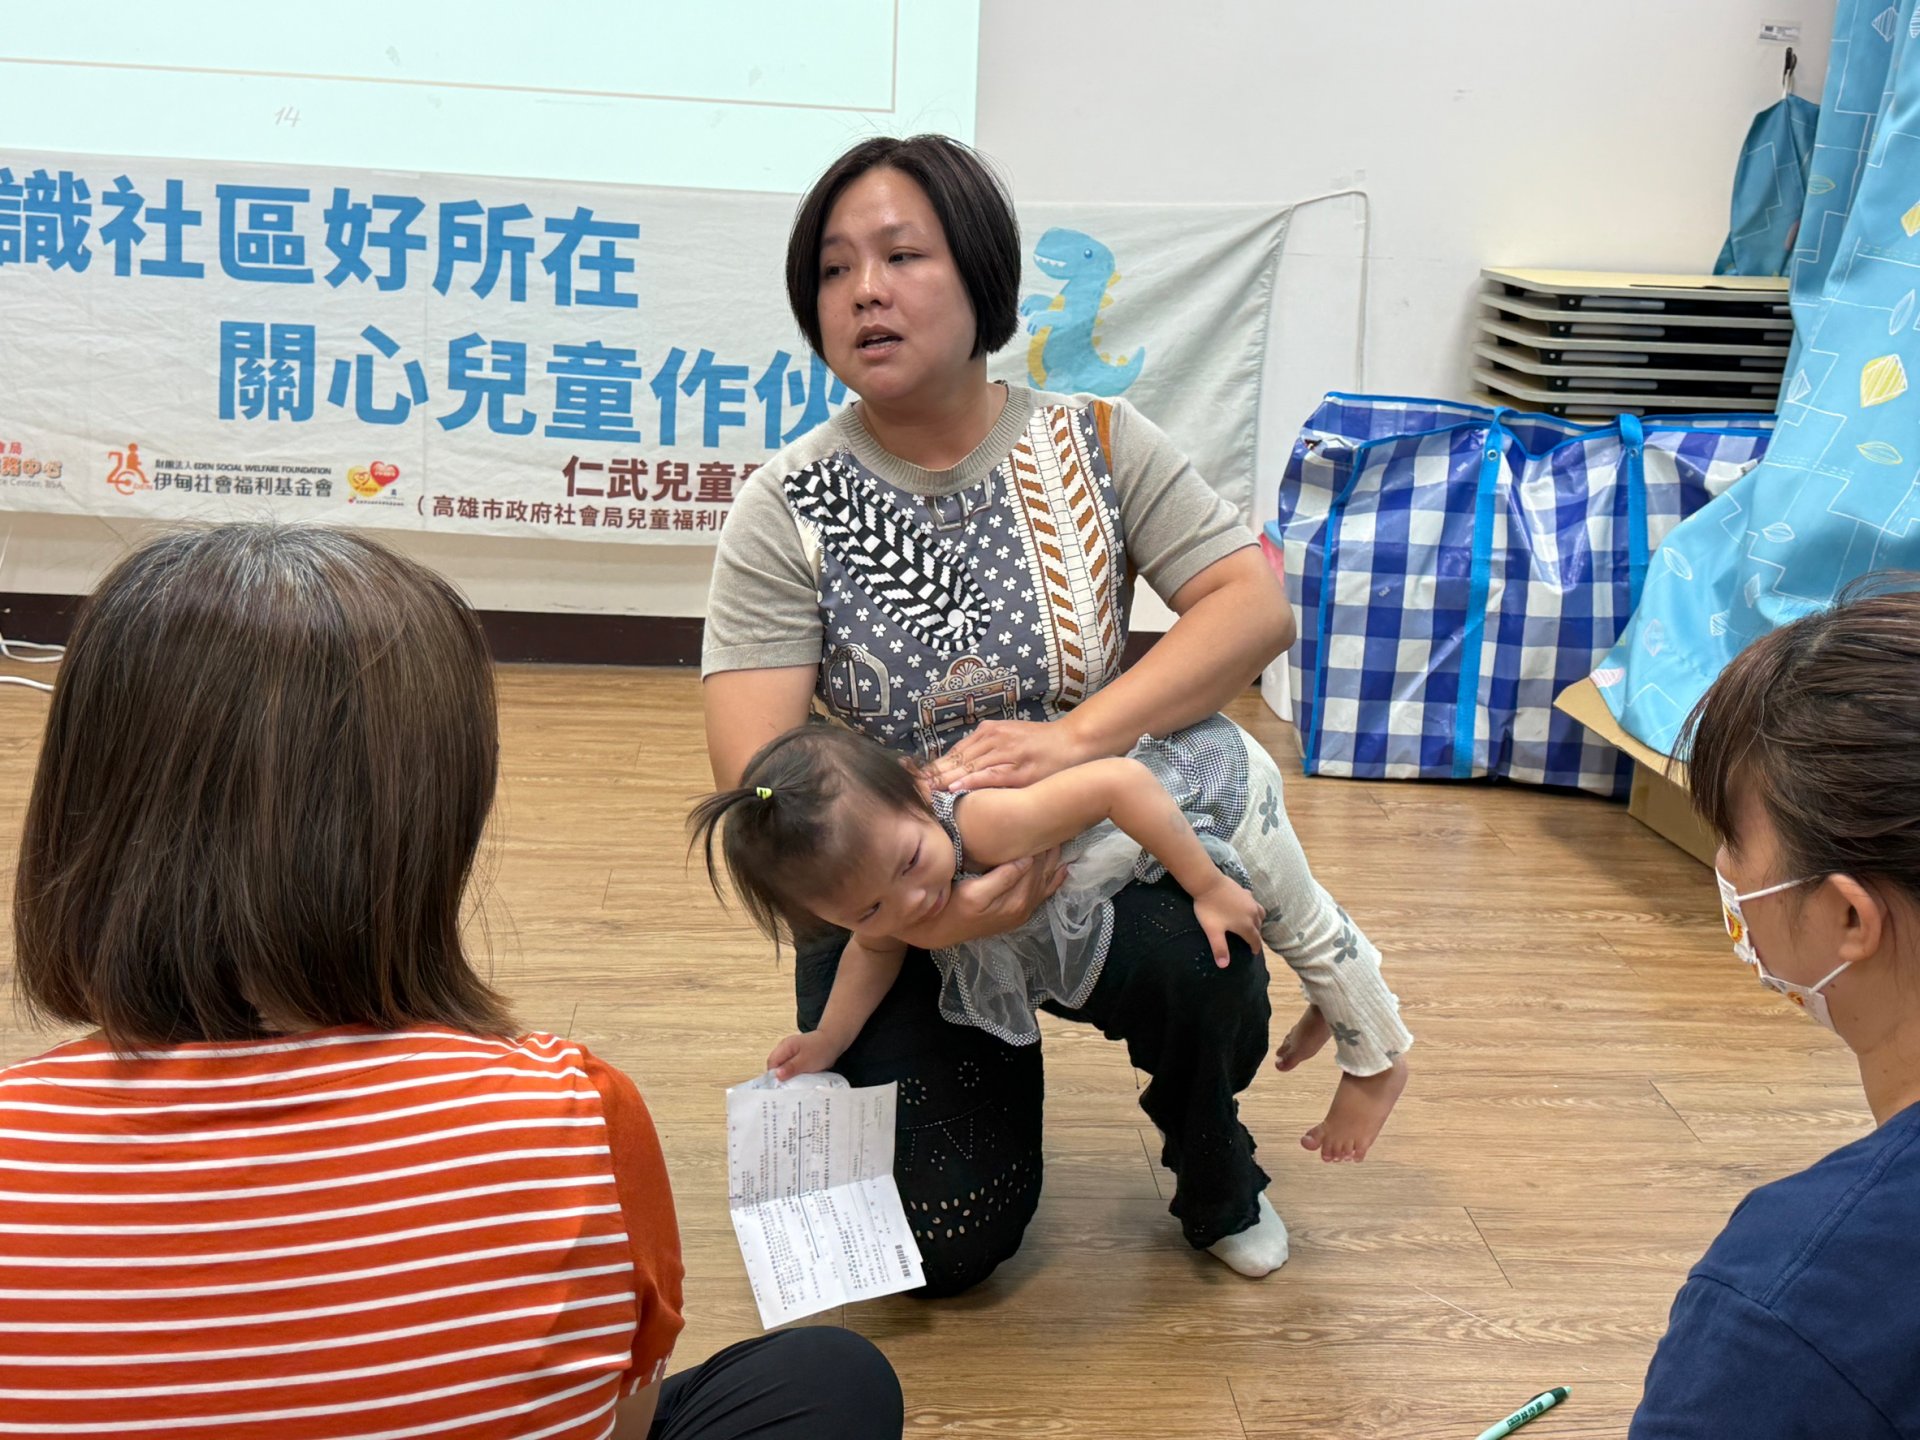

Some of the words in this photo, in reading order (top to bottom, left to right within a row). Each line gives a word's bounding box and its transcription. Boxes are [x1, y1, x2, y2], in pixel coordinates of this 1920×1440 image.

[274, 105, 301, 128] 14
[0, 166, 640, 309] 識社區好所在
[217, 320, 848, 450] 關心兒童作伙
[154, 472, 333, 498] 伊甸社會福利基金會
[193, 462, 214, 470] EDEN
[216, 463, 242, 472] SOCIAL
[244, 464, 280, 473] WELFARE
[281, 465, 332, 475] FOUNDATION
[561, 455, 766, 505] 仁武兒童
